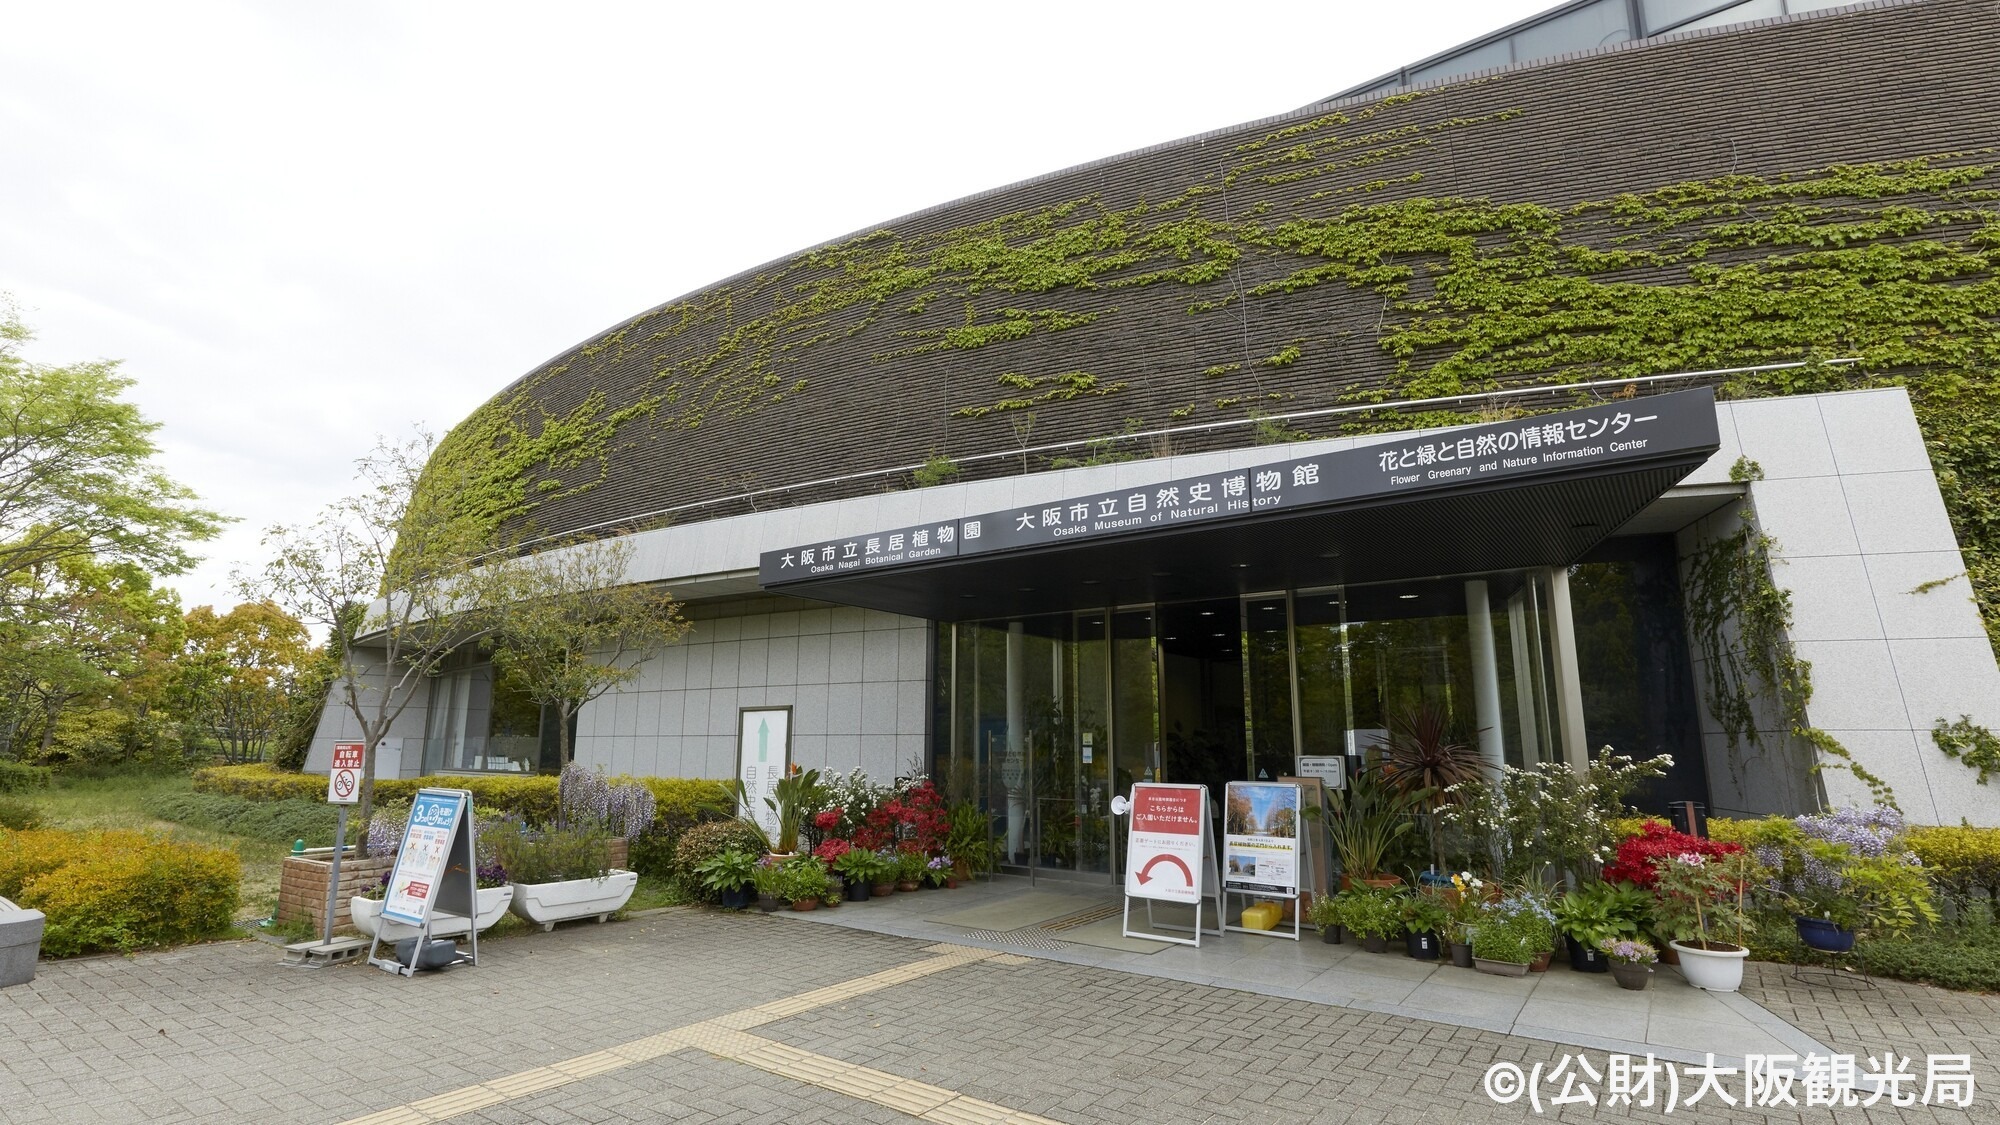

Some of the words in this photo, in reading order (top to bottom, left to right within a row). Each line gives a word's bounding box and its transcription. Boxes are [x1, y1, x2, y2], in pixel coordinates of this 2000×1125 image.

[1379, 411, 1658, 473] 花と緑と自然の情報センター
[1390, 472, 1420, 486] Flower
[1427, 465, 1472, 481] Greenary
[1479, 460, 1498, 473] and
[1502, 454, 1538, 470] Nature
[1542, 445, 1604, 463] Information
[1609, 437, 1648, 454] Center
[1016, 462, 1320, 532] 大阪市立自然史博物館
[1053, 523, 1087, 537] Osaka
[1094, 515, 1142, 531] Museum
[1149, 511, 1163, 523] of
[1170, 503, 1219, 520] Natural
[1227, 494, 1282, 512] History
[780, 520, 982, 570] 大阪市立長居植物園
[810, 562, 834, 574] Osaka
[838, 557, 861, 570] Nagai
[865, 552, 904, 566] Botanical
[908, 546, 941, 560] Garden
[339, 750, 358, 759] 自転車
[765, 766, 779, 841] 長居物園
